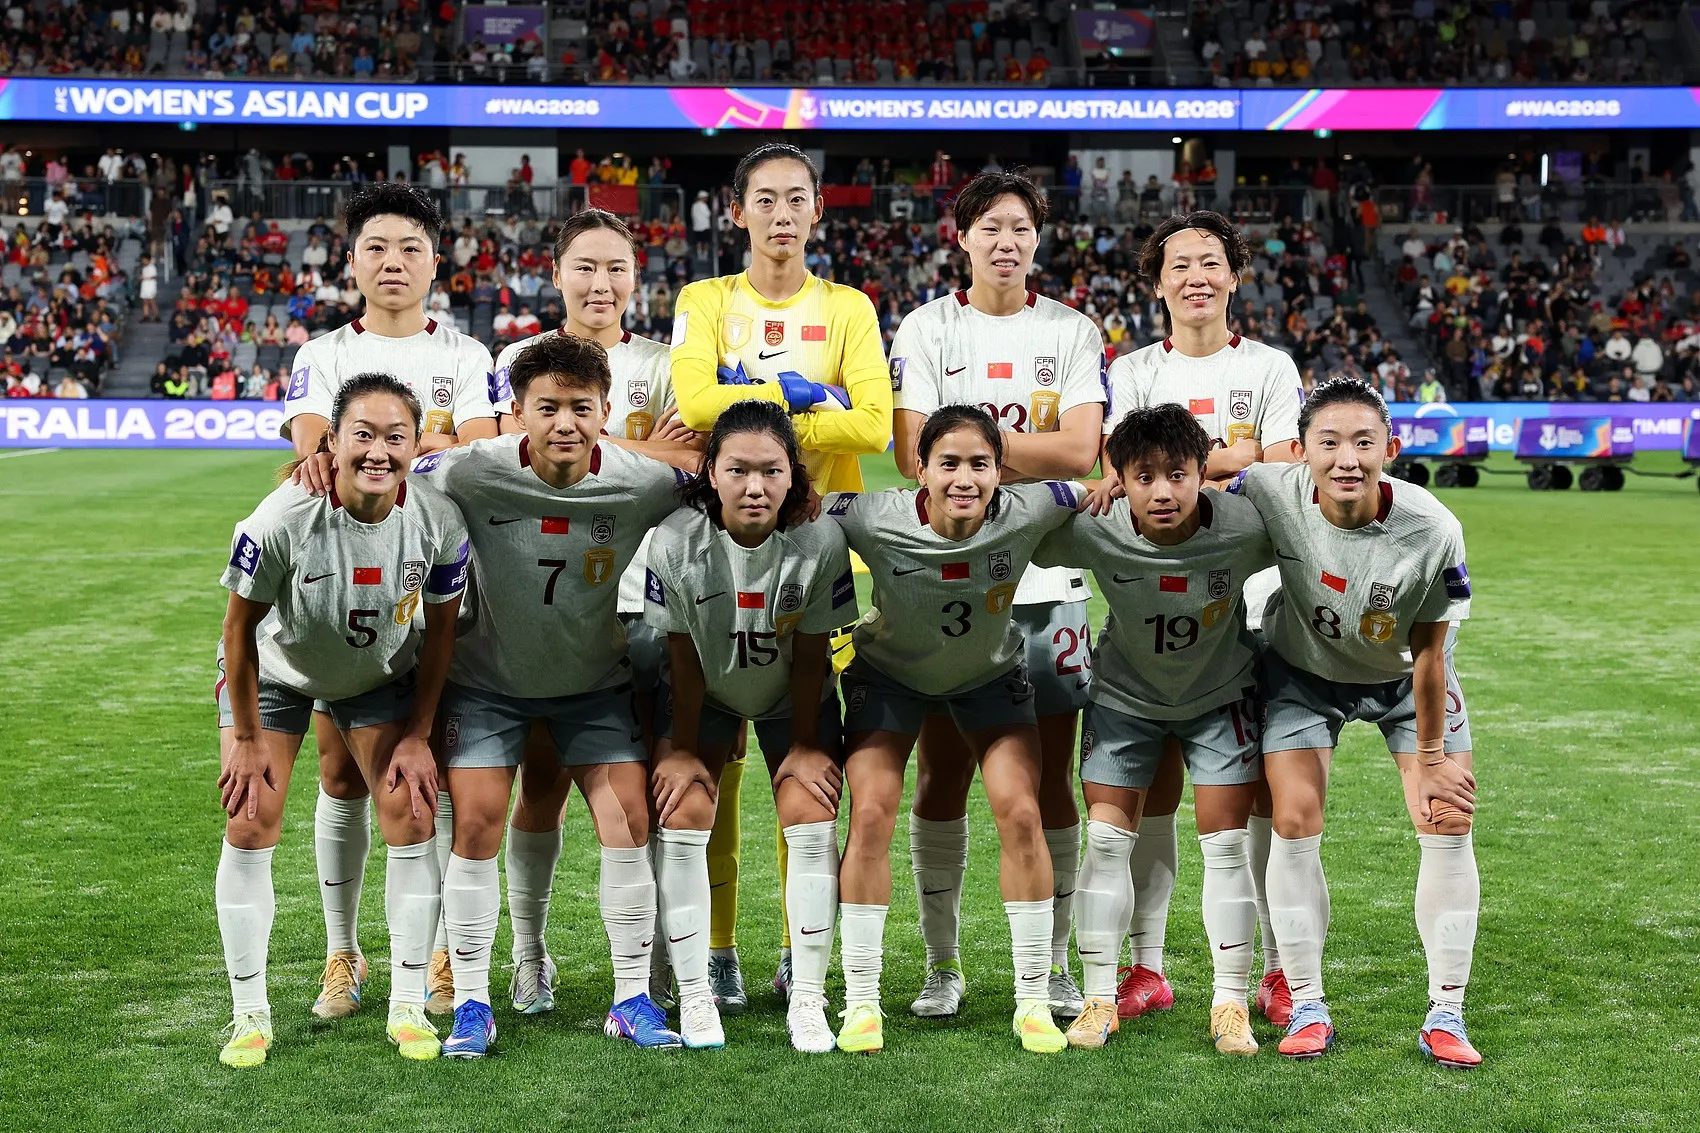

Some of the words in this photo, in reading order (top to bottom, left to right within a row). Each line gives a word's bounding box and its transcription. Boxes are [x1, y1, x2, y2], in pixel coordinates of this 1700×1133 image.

[69, 87, 235, 116] WOMEN'S
[241, 90, 349, 118] ASIAN
[354, 91, 429, 119] CUP
[485, 99, 600, 115] #WAC2026
[829, 99, 925, 118] WOMEN'S
[928, 100, 991, 118] ASIAN
[993, 100, 1038, 118] CUP
[1038, 100, 1172, 118] AUSTRALIA
[1174, 100, 1236, 118] 2026
[1505, 99, 1621, 116] #WAC2026
[0, 407, 156, 440] RALIA
[537, 558, 567, 606] 7
[345, 609, 379, 648] 5
[941, 600, 972, 637] 3
[1144, 614, 1199, 654] 19
[1312, 605, 1341, 639] 8
[729, 631, 778, 669] 15
